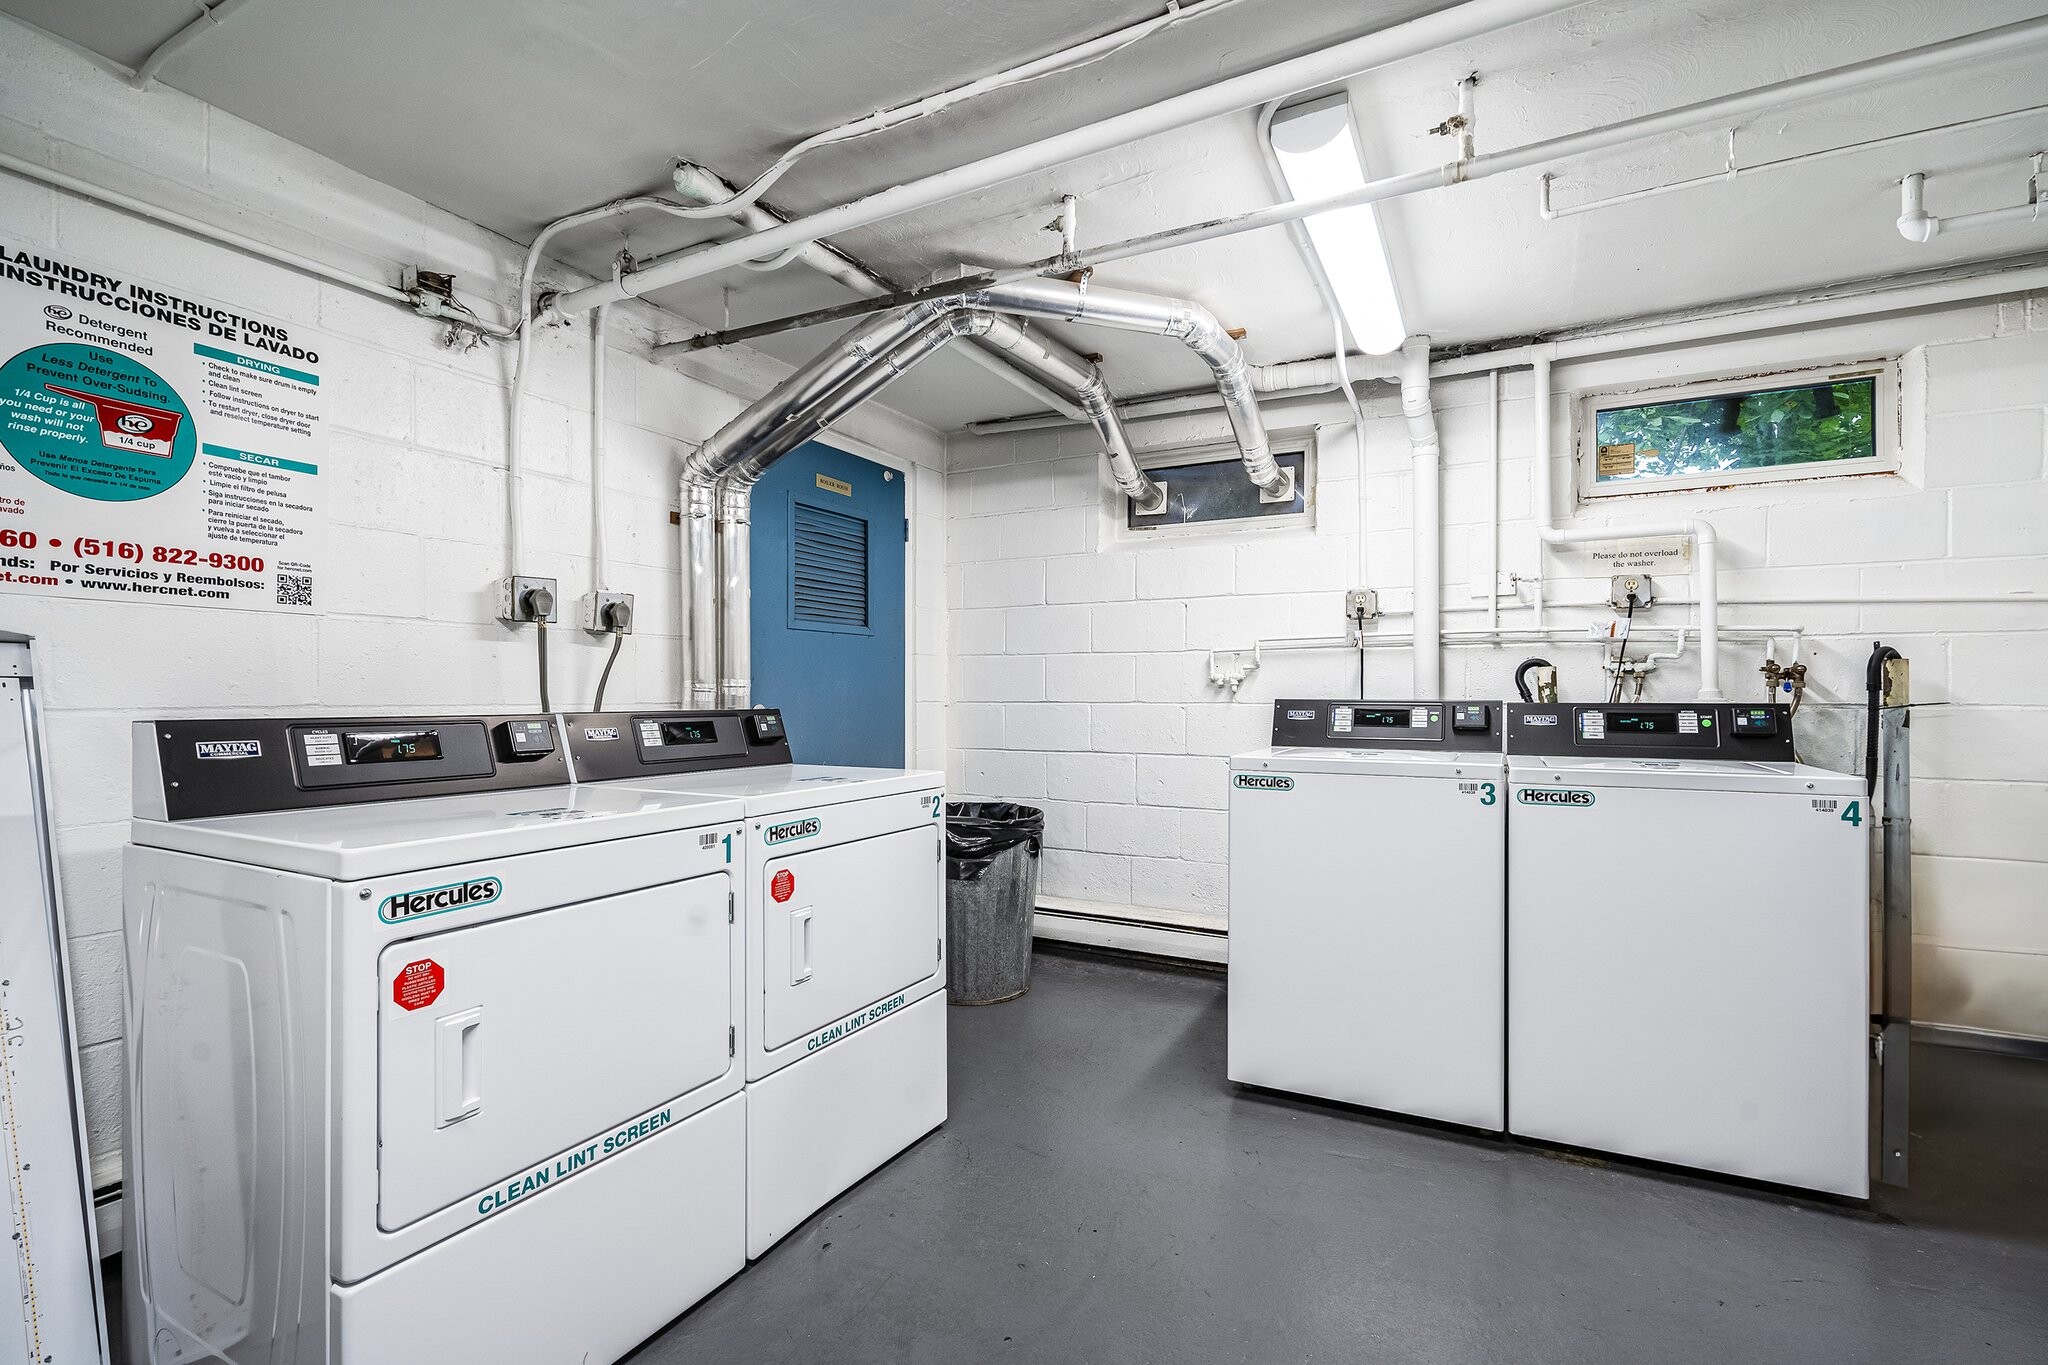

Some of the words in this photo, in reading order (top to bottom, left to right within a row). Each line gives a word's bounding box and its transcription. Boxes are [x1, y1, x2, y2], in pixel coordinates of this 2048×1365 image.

[0, 245, 122, 293] LAUNDRY
[130, 284, 288, 341] INSTRUCTIONS
[0, 262, 201, 331] INSTRUCCIONES
[209, 322, 236, 342] DE
[244, 332, 319, 364] LAVADO
[79, 313, 148, 341] Detergent
[46, 320, 153, 356] Recommended
[89, 351, 113, 365] Use
[236, 356, 280, 374] DRYING
[42, 353, 73, 368] Less
[78, 362, 140, 383] Detergent
[143, 376, 157, 387] To
[208, 370, 221, 378] and
[222, 374, 240, 383] clean
[208, 362, 230, 373] Check
[231, 367, 238, 375] to
[240, 370, 257, 380] make
[259, 375, 272, 384] sure
[274, 379, 290, 389] drum
[298, 386, 317, 396] empty
[27, 363, 78, 383] Prevent
[83, 375, 171, 403] Over-Sudsing.
[208, 379, 227, 390] Clean
[229, 384, 239, 393] lint
[241, 388, 262, 398] screen
[14, 388, 31, 399] 1/4
[34, 392, 57, 405] Cup
[60, 398, 70, 408] is
[73, 400, 86, 410] all
[209, 390, 231, 401] Follow
[233, 395, 270, 410] instructions
[280, 407, 296, 418] dryer
[306, 413, 319, 422] start
[0, 397, 22, 408] you
[24, 401, 53, 414] need
[56, 408, 67, 417] or
[70, 412, 95, 424] your
[208, 399, 217, 408] To
[219, 402, 240, 413] restart
[242, 407, 259, 419] dryer,
[261, 412, 278, 422] close
[279, 416, 295, 427] dryer
[297, 420, 311, 429] door
[11, 411, 41, 423] wash
[44, 417, 63, 428] will
[66, 421, 84, 432] not
[224, 411, 250, 423] reselect
[252, 418, 289, 432] temperature
[291, 426, 311, 437] setting
[8, 422, 37, 433] rinse
[40, 429, 89, 444] properly.
[119, 436, 134, 446] 1/4
[136, 441, 156, 450] cup
[38, 450, 56, 459] Use
[59, 454, 88, 465] Menos
[91, 459, 136, 472] Detergente
[138, 467, 156, 476] Para
[240, 452, 279, 467] SECAR
[30, 457, 67, 470] Prevenir
[82, 466, 112, 477] Exceso
[129, 474, 163, 485] Espuma.
[44, 469, 60, 477] Todo
[208, 461, 246, 475] Compruebe
[248, 470, 260, 478] que
[269, 473, 290, 482] tambor
[248, 476, 268, 486] limpio
[209, 479, 231, 490] Limpie
[240, 484, 255, 493] filtro
[266, 489, 287, 499] pelusa
[14, 498, 25, 506] de
[208, 489, 223, 499] Siga
[224, 493, 267, 505] instrucciones
[285, 502, 313, 512] secadora
[208, 498, 223, 506] para
[224, 500, 245, 508] iniciar
[246, 503, 269, 512] secado
[208, 508, 223, 517] Para
[225, 511, 251, 521] reiniciar
[260, 517, 284, 526] secado,
[208, 517, 227, 525] cierre
[236, 521, 257, 530] puerta
[275, 526, 303, 535] secadora
[208, 532, 228, 541] ajuste
[239, 535, 278, 546] temperatura
[213, 525, 234, 534] vuelva
[241, 529, 278, 540] seleccionar
[0, 529, 37, 549] 60
[74, 537, 144, 564] (516)
[152, 546, 264, 572] 822-9300
[1592, 552, 1616, 560] Please
[1618, 551, 1628, 559] do
[1644, 549, 1679, 557] overload
[1627, 559, 1656, 567] washer.
[50, 560, 79, 573] Por
[84, 564, 158, 579] Servicios
[164, 573, 172, 582] y
[176, 572, 265, 589] Reembolsos:
[80, 579, 230, 599] www.hercnet.com
[200, 742, 257, 753] MAYTAG
[1239, 775, 1290, 788] Hercules
[1480, 782, 1496, 805] 3
[1524, 789, 1590, 803] Hercules
[932, 795, 941, 818] 2
[1841, 800, 1862, 827] 4
[770, 820, 817, 841] Hercules
[722, 833, 731, 863] 1
[390, 882, 495, 918] Hercules
[406, 961, 432, 974] STOP
[808, 1025, 842, 1051] CLEAN
[845, 1013, 866, 1033] LINT
[869, 994, 905, 1020] SCREEN
[478, 1167, 549, 1214] CLEAN
[556, 1144, 598, 1178] LINT
[603, 1108, 671, 1154] SCREEN
